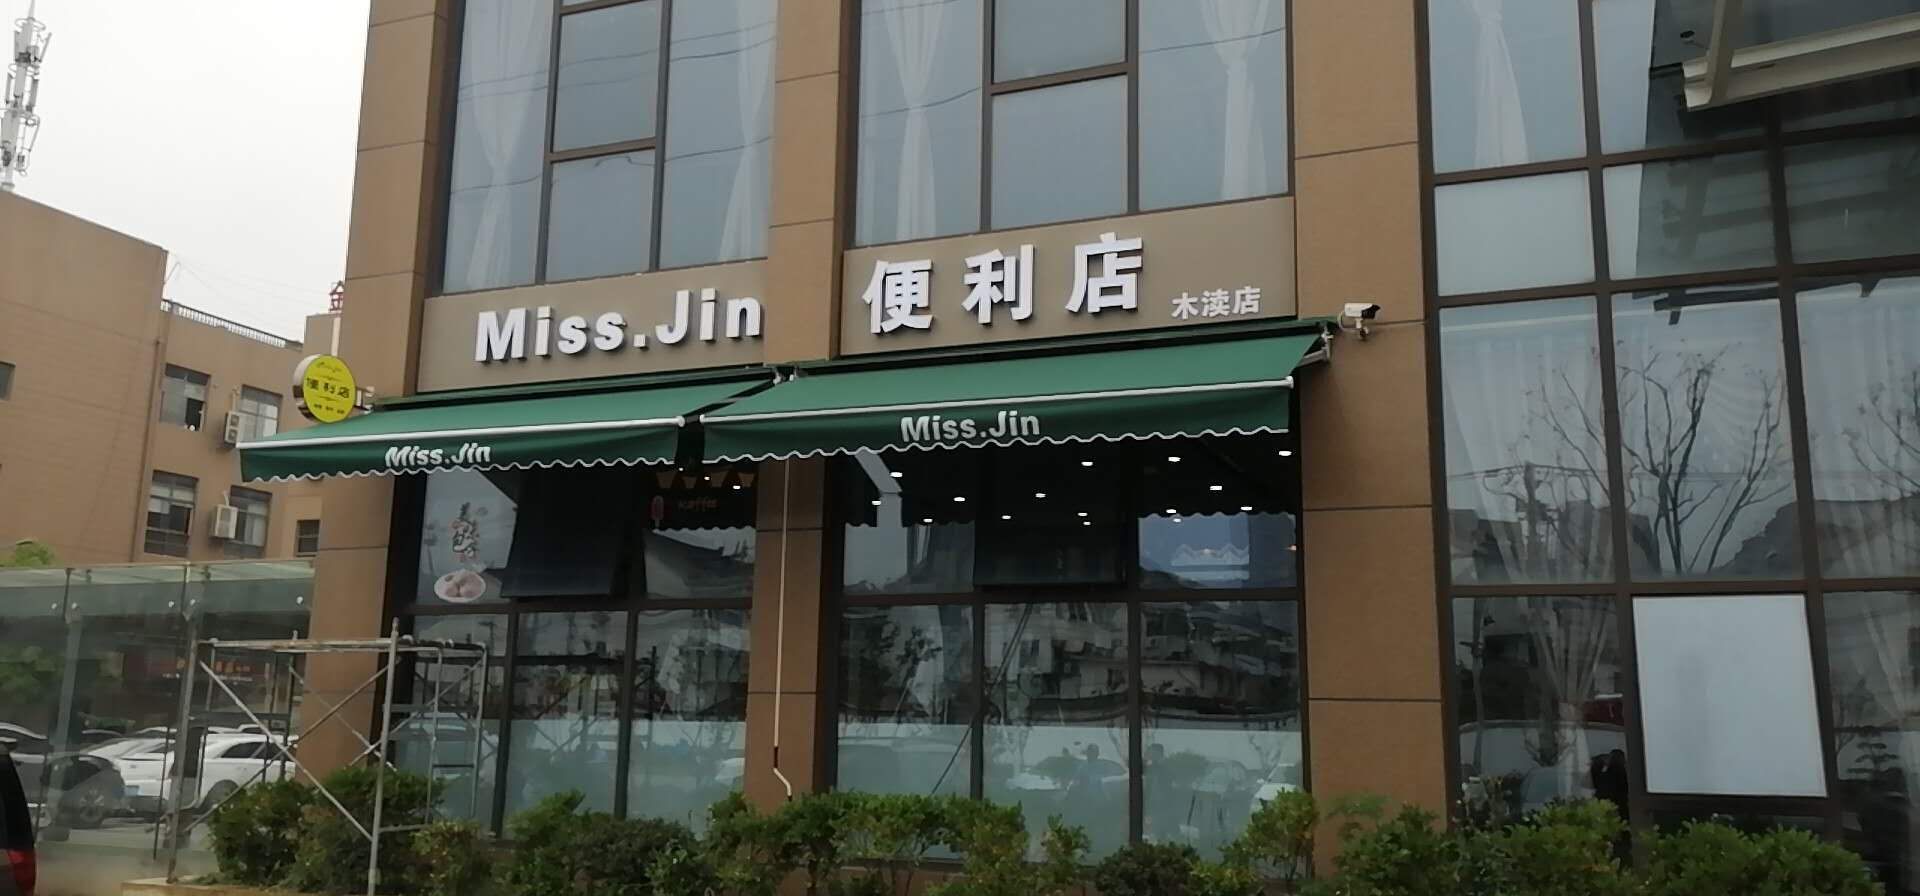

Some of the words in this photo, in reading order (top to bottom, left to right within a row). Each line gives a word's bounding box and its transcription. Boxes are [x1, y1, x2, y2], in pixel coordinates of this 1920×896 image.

[862, 232, 1143, 335] 便利店
[1171, 286, 1261, 320] 木渎店
[475, 288, 762, 362] Miss.Jin
[901, 410, 1040, 443] Miss.Jin
[385, 442, 491, 467] Miss.Jin
